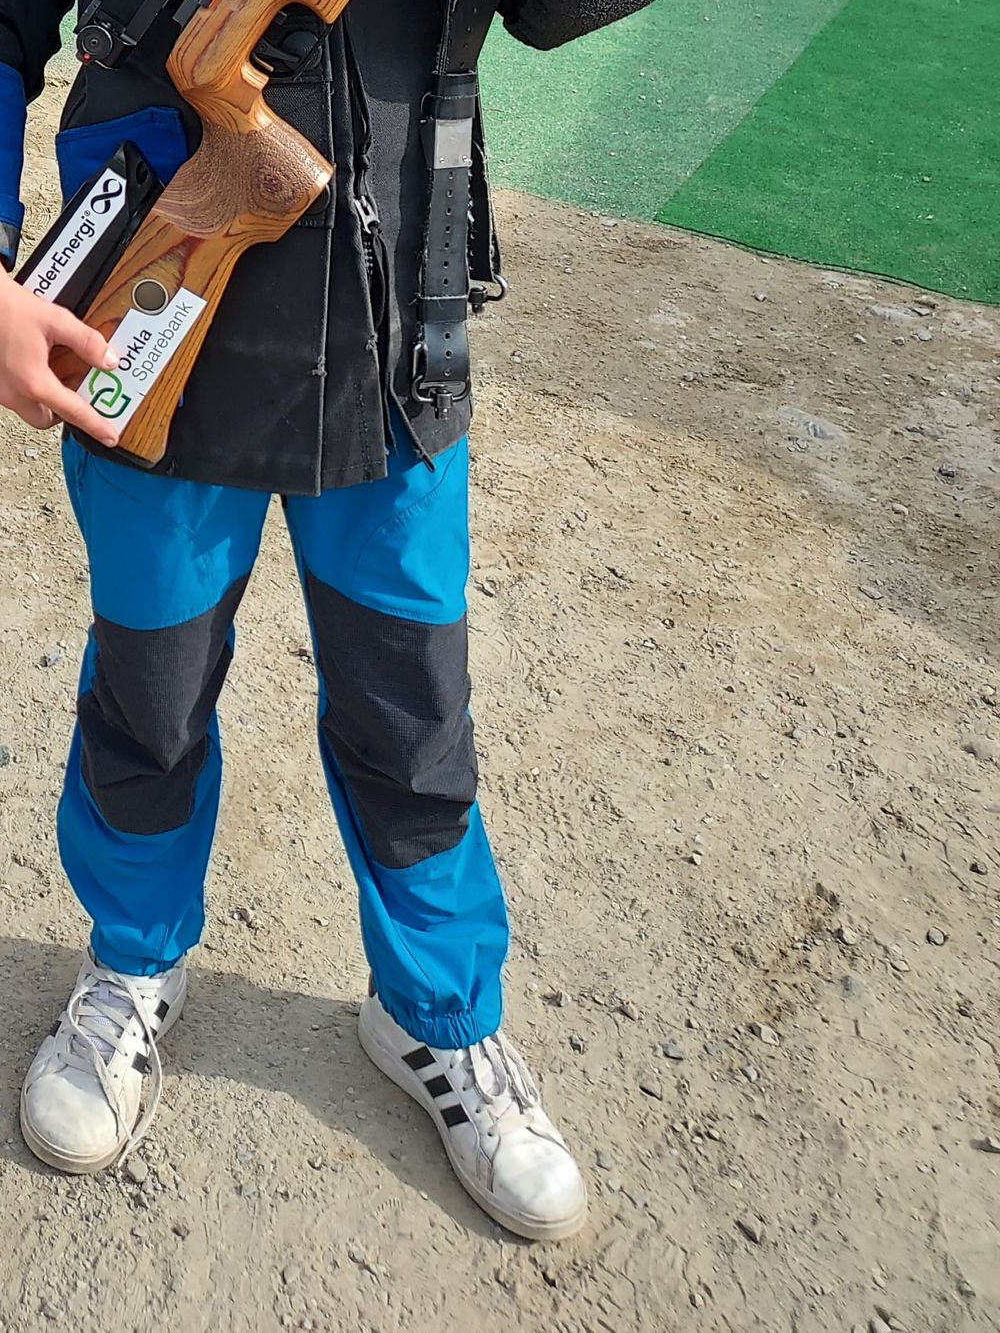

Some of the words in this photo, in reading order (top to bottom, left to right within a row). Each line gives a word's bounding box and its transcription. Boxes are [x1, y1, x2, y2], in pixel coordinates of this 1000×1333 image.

[32, 216, 96, 299] nderEnergi
[117, 328, 154, 372] Orkla
[131, 300, 194, 382] Sparebank
